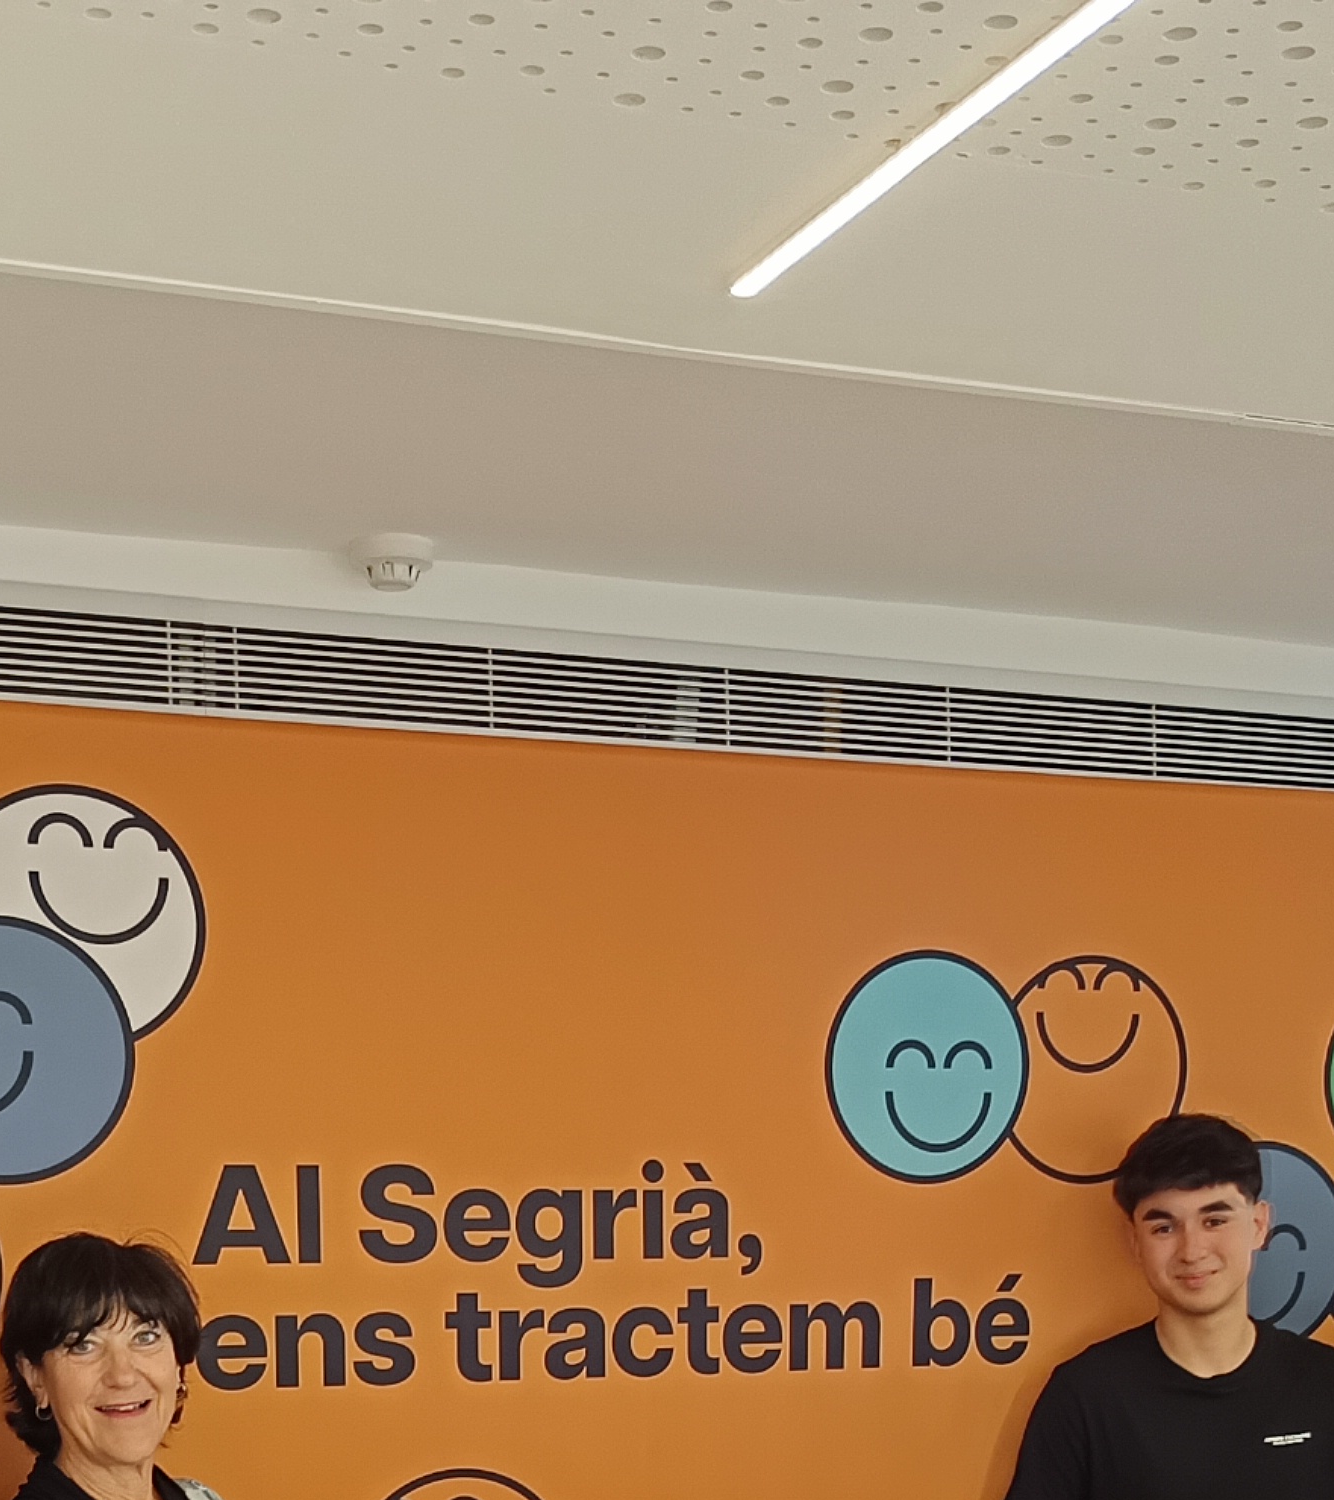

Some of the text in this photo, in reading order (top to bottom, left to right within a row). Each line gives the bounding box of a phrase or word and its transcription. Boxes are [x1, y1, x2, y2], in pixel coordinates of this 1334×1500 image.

[192, 1159, 764, 1289] Al Segrià,
[196, 1273, 1031, 1391] ens tractem bé
